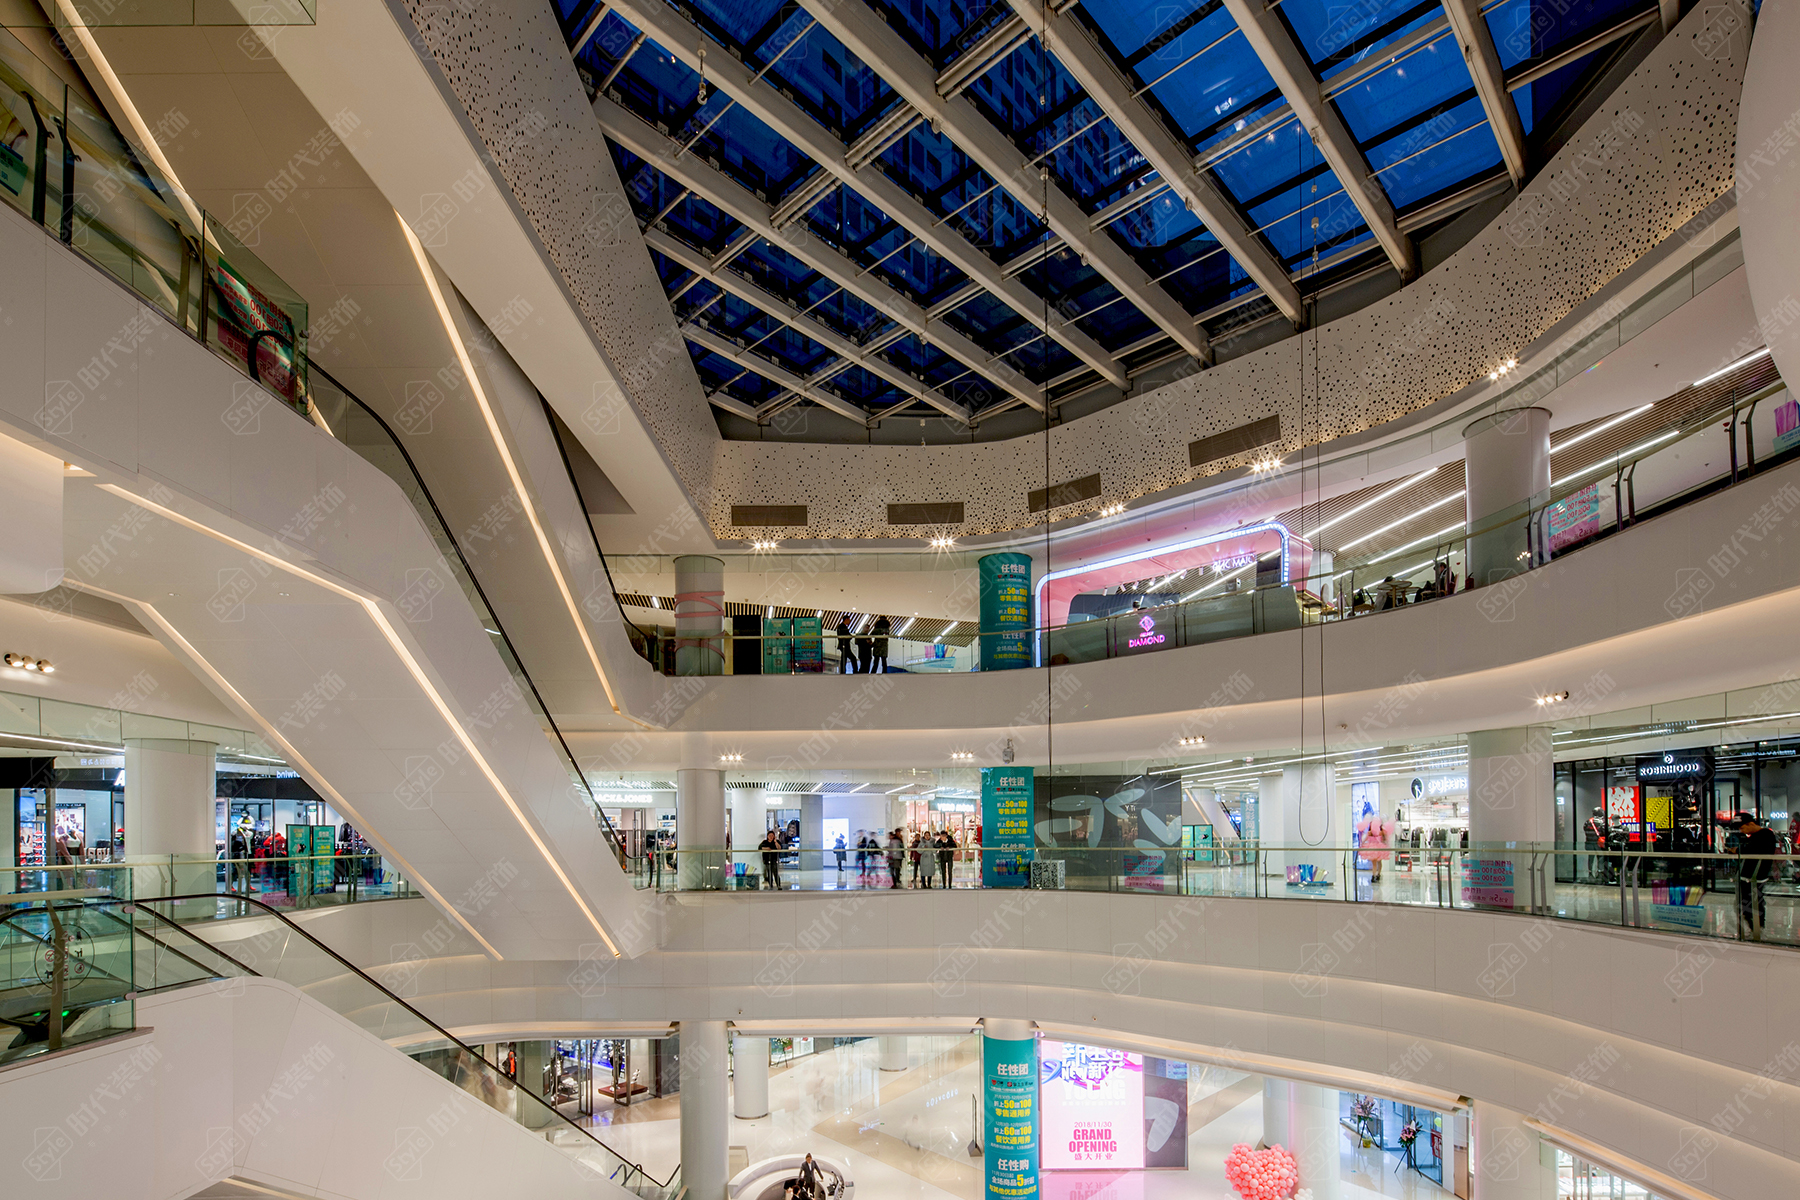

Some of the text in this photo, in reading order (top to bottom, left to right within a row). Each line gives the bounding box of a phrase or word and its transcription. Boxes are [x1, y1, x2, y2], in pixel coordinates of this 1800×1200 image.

[1001, 564, 1025, 574] 任性团
[1128, 634, 1166, 648] DIAMOND
[1000, 777, 1025, 786] 任性团
[593, 793, 653, 803] ACK&JONES
[997, 1063, 1028, 1076] 任性团
[995, 1108, 1031, 1117] 零售通用券
[1073, 1128, 1112, 1140] GRAND
[995, 1135, 1031, 1145] 餐饮通用券
[1068, 1140, 1117, 1152] OPENING
[998, 1158, 1029, 1171] 任性购
